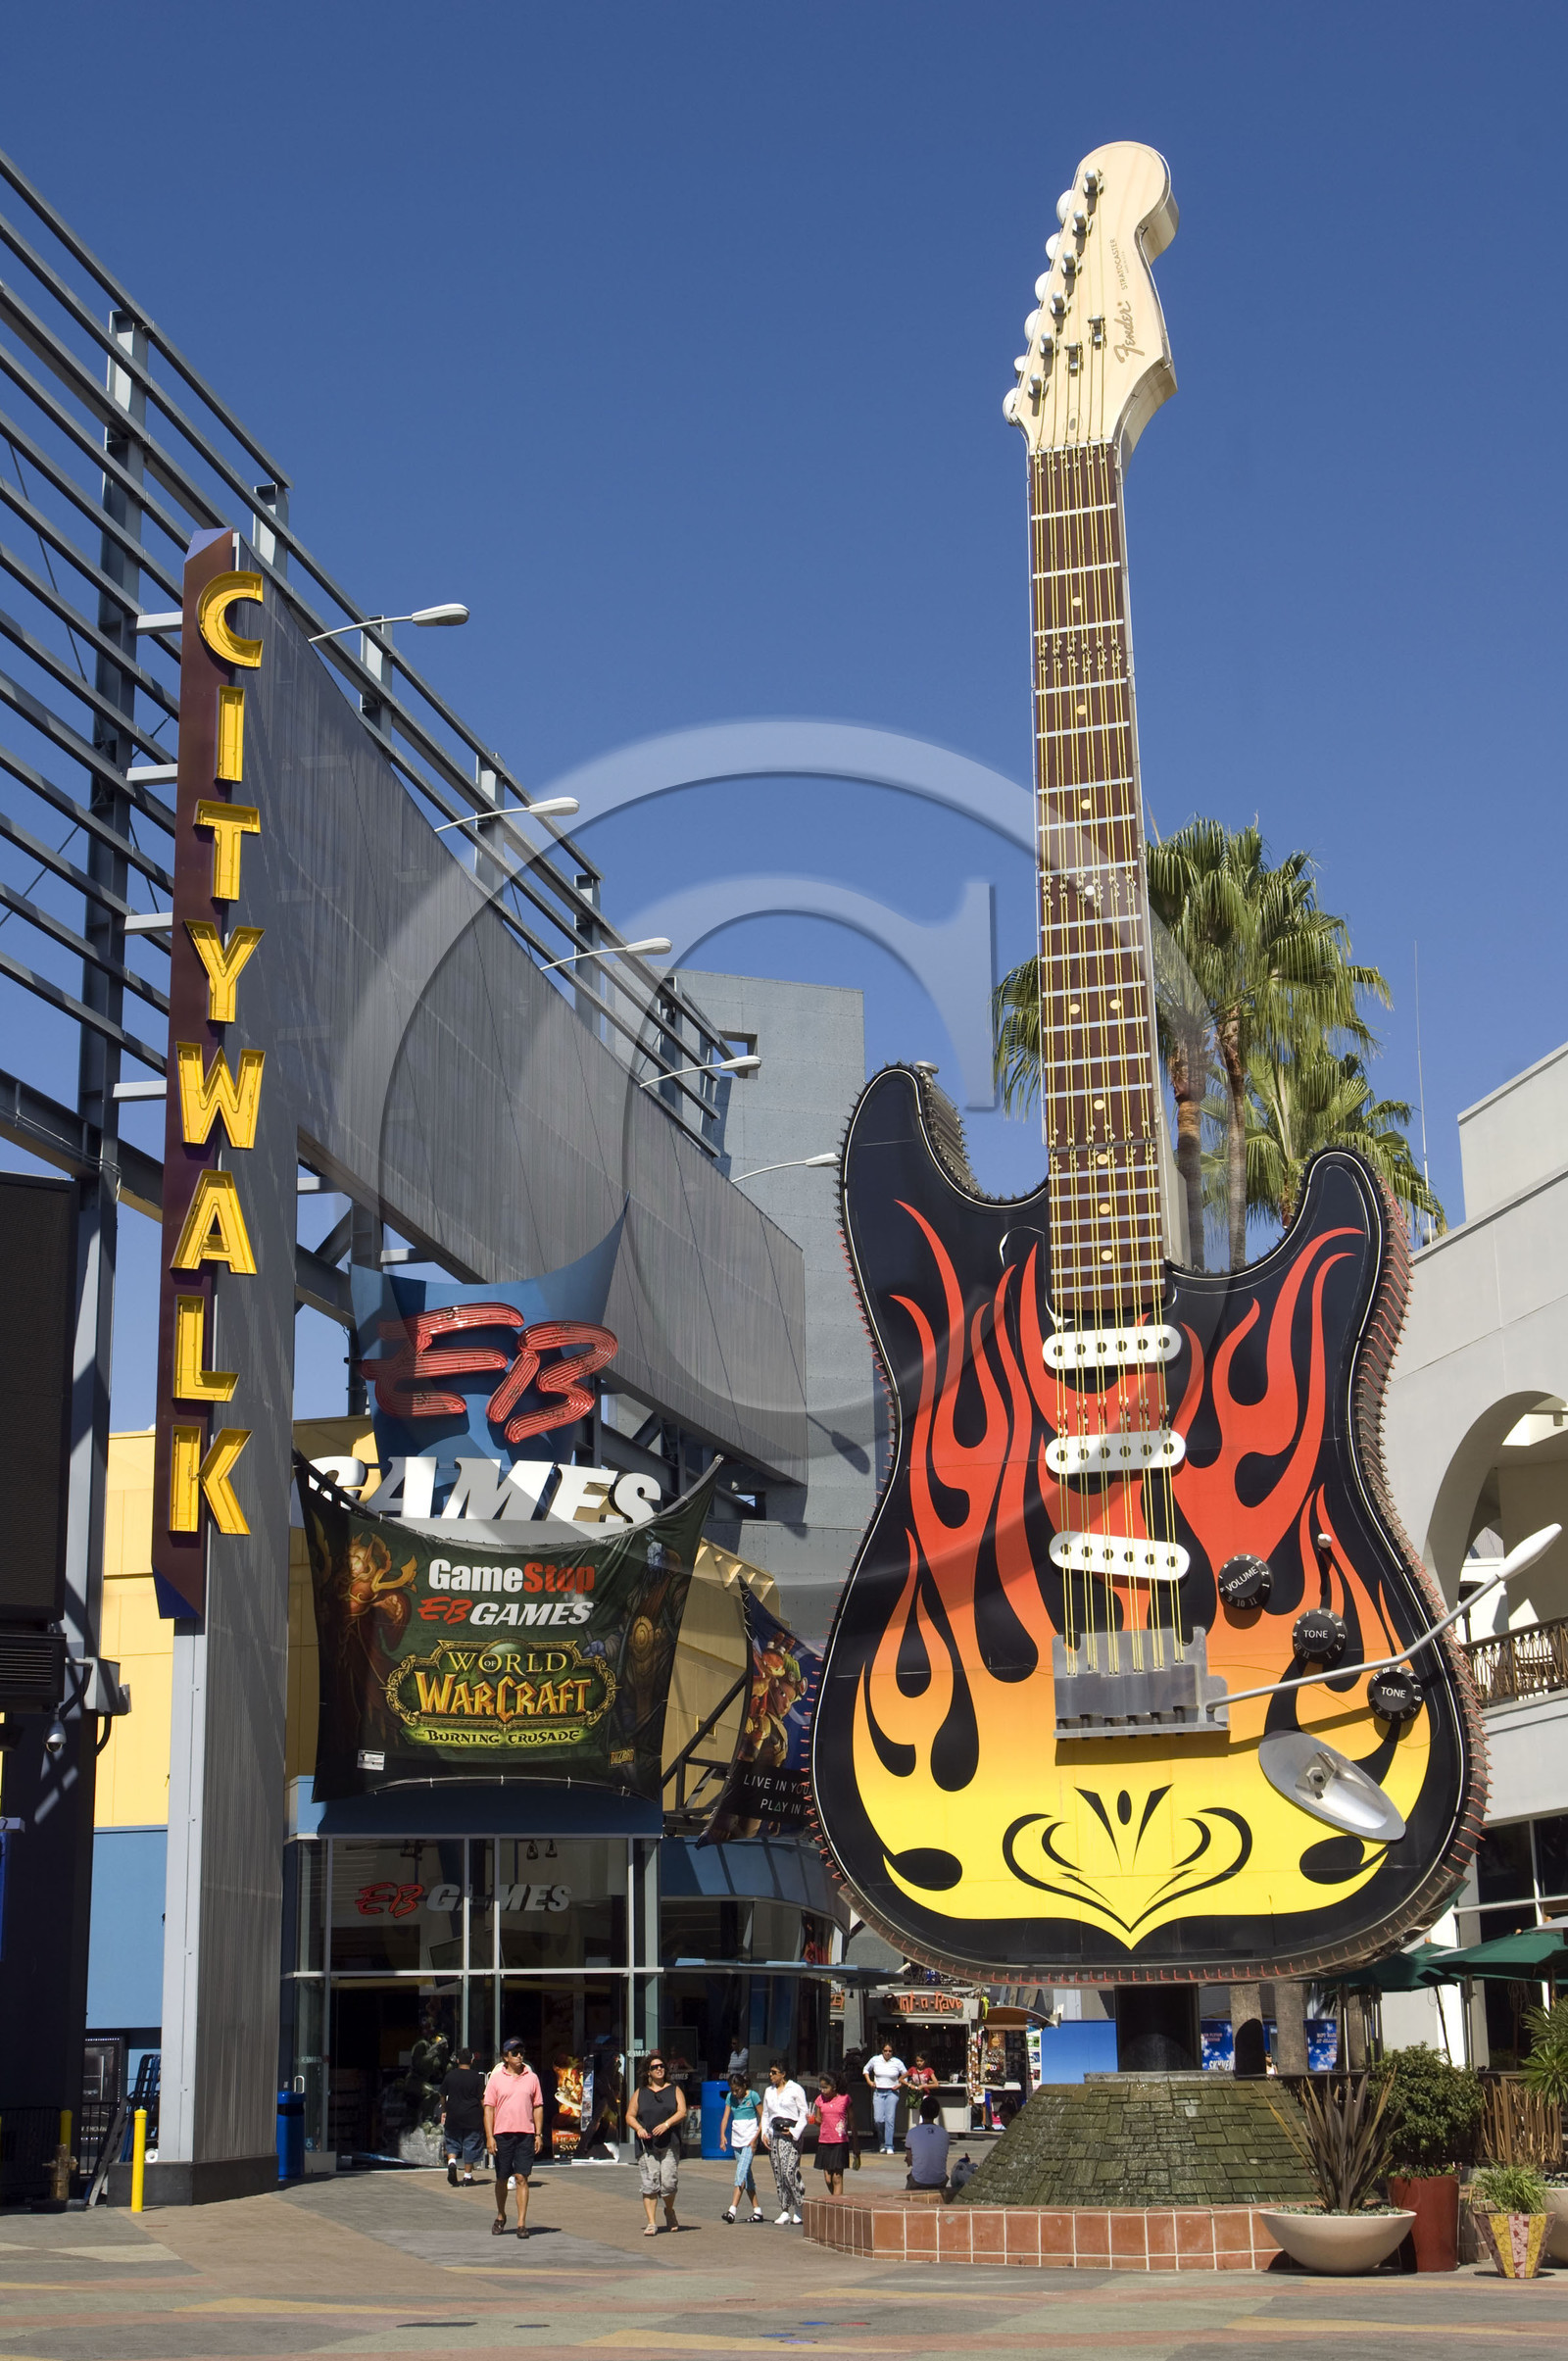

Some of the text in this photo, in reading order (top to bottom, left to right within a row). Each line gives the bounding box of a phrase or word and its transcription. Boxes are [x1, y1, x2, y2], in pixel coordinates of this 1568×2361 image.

[1109, 238, 1128, 290] STRATOCASTER
[1113, 300, 1145, 364] Fender
[168, 570, 266, 1536] CITYWALK
[362, 1302, 619, 1444] EB
[309, 1455, 662, 1525] GAMES
[428, 1558, 595, 1595] GameStop
[1225, 1565, 1259, 1592] VOLUME
[417, 1597, 595, 1626] EB GAMES
[1303, 1629, 1328, 1639] TONE
[447, 1651, 567, 1676] WORLD
[414, 1671, 592, 1723] WARCRAFT
[1381, 1686, 1407, 1698] TONE
[426, 1729, 500, 1745] BURNING
[508, 1729, 580, 1745] CRUSADE
[743, 1774, 812, 1795] LIVE IN YOU
[791, 1804, 802, 1814] IN
[355, 1882, 424, 1918] EB
